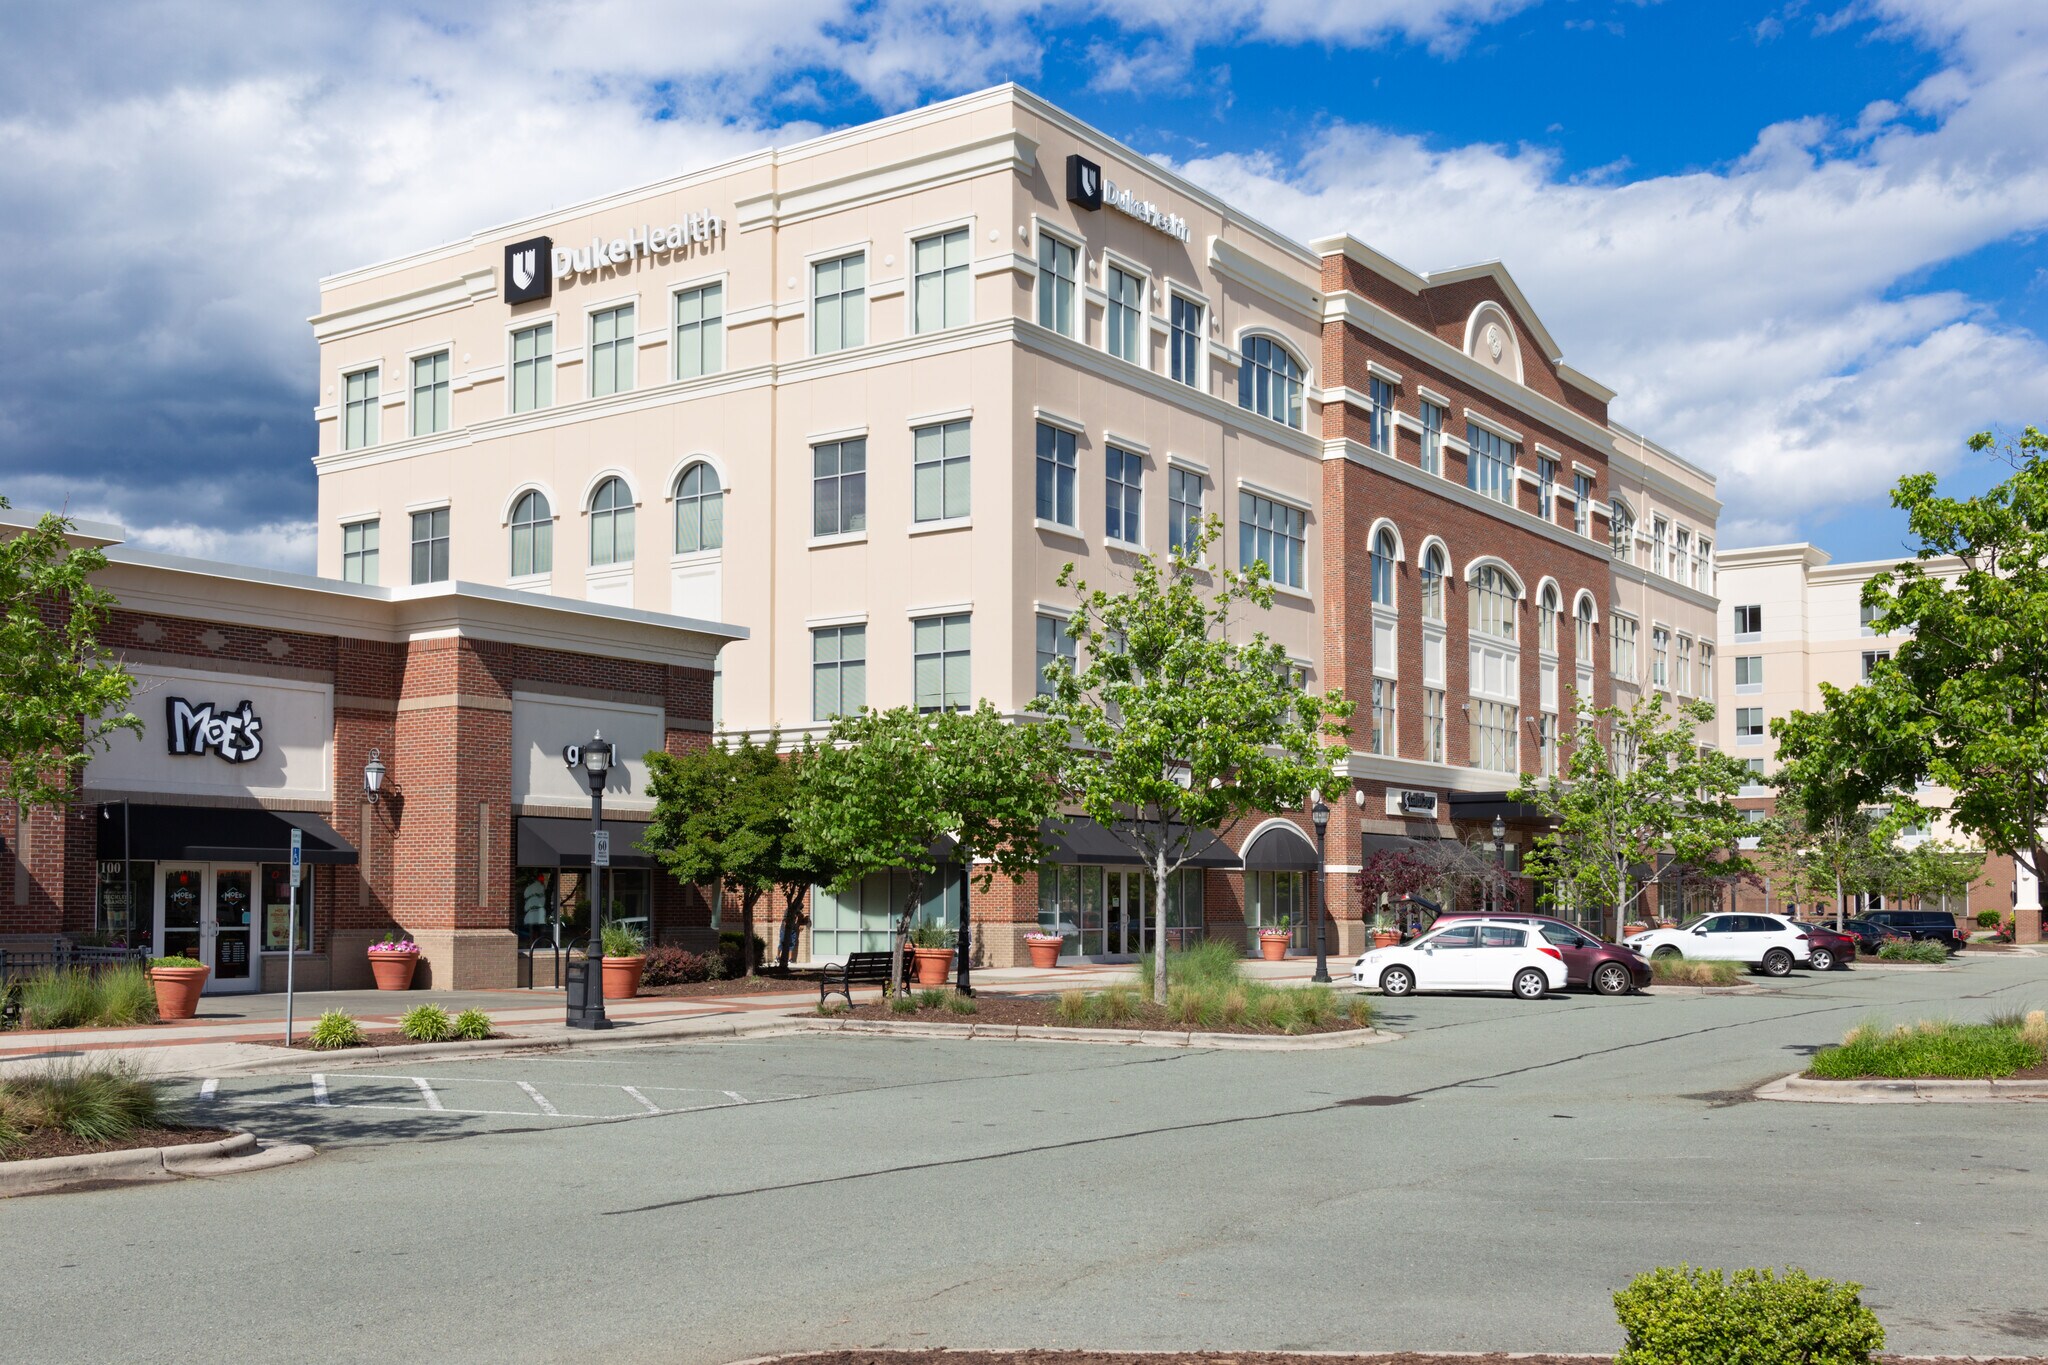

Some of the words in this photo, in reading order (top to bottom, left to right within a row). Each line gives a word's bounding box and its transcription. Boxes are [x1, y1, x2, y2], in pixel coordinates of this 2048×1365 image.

[551, 208, 722, 279] DukeHealth
[598, 840, 607, 851] 60
[101, 862, 121, 873] 100
